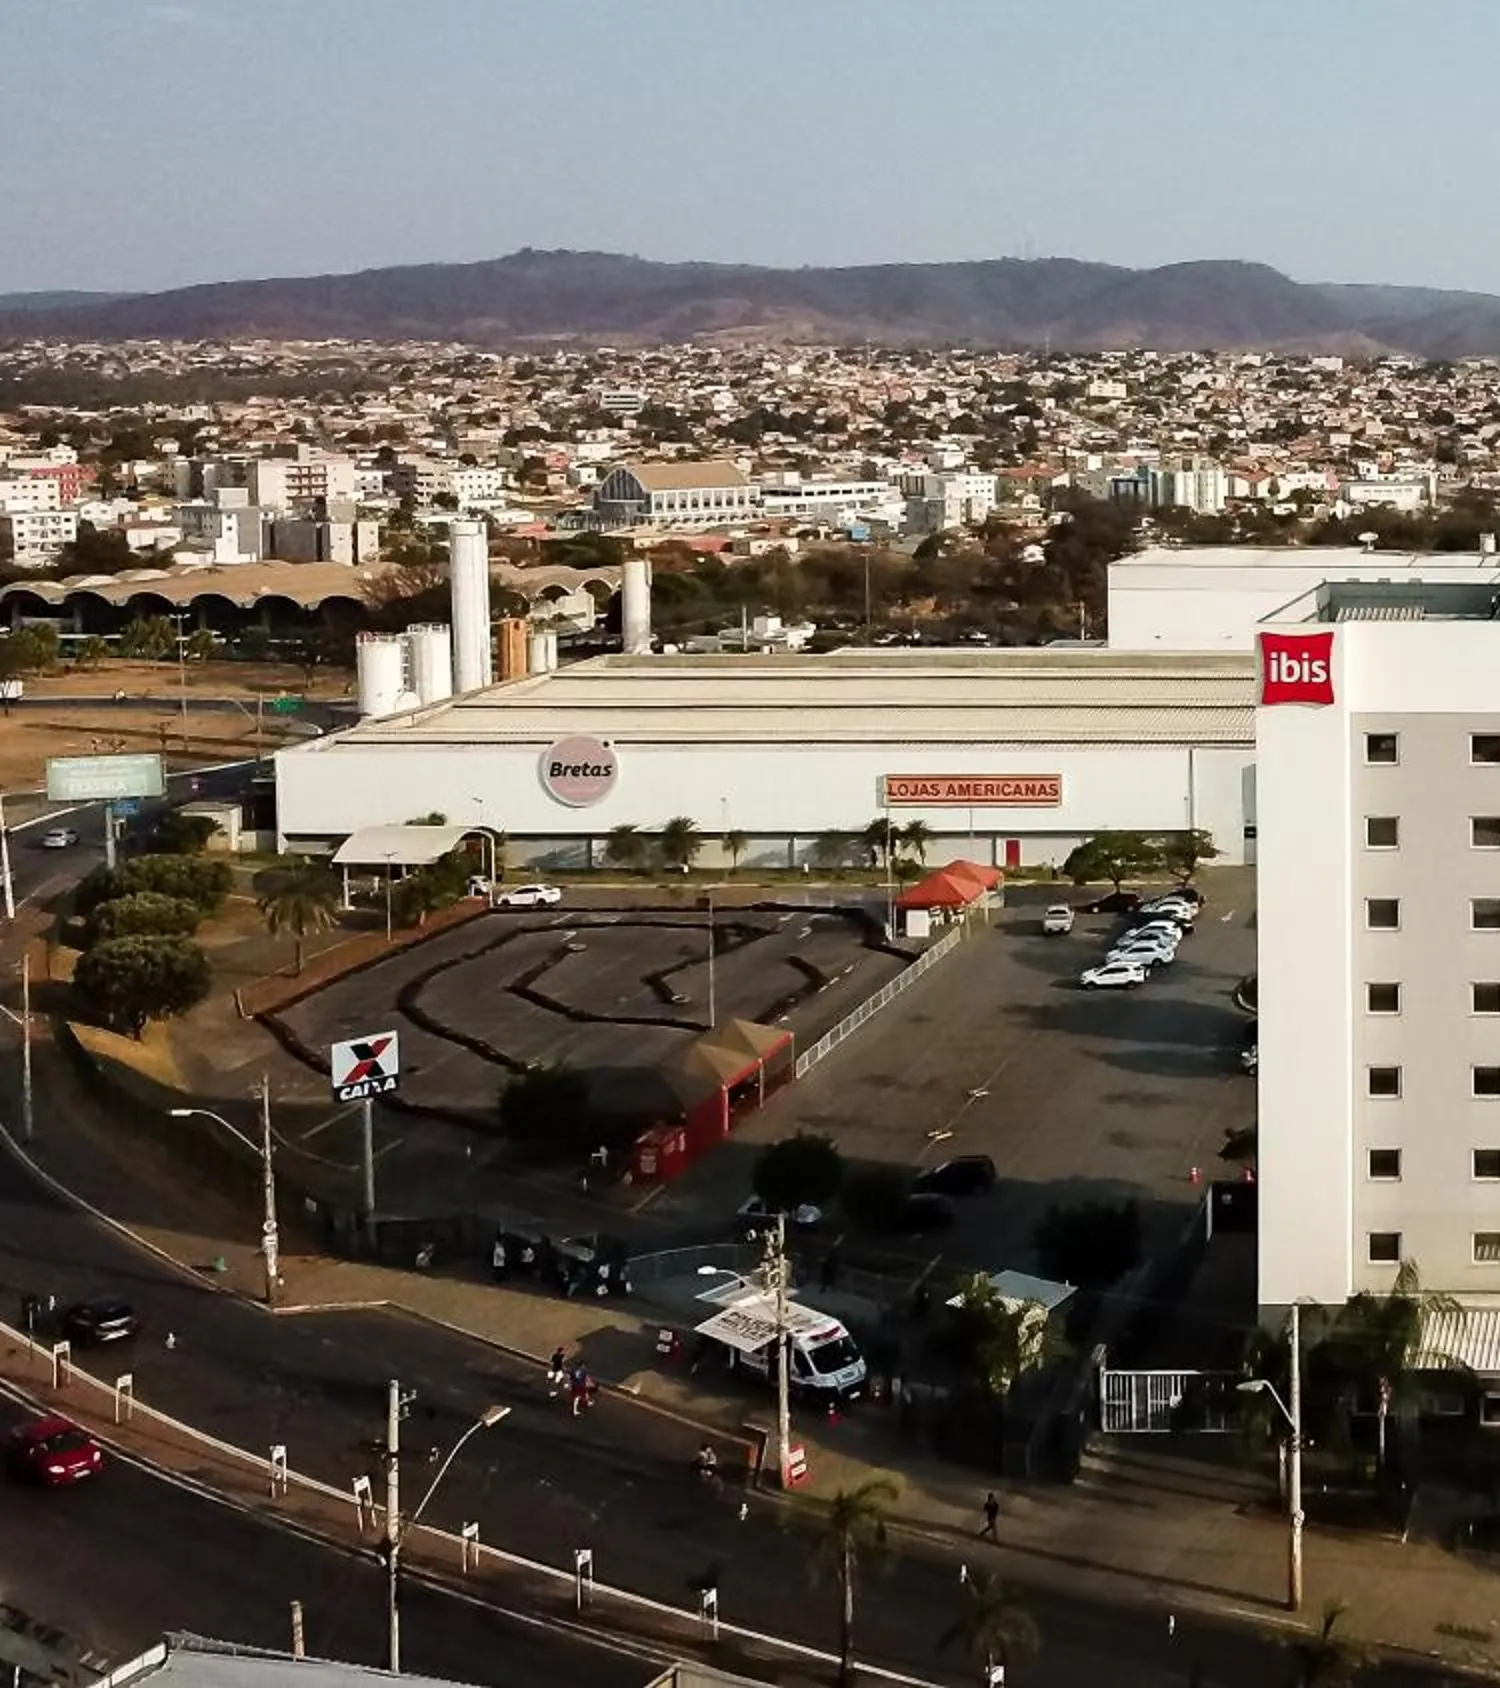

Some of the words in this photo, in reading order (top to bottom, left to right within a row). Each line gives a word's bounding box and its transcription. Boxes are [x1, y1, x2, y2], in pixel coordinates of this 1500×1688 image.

[1270, 651, 1328, 684] ibis
[549, 761, 613, 777] Bretas
[887, 783, 941, 797] LOJAS
[945, 783, 1060, 797] AMERICANAS
